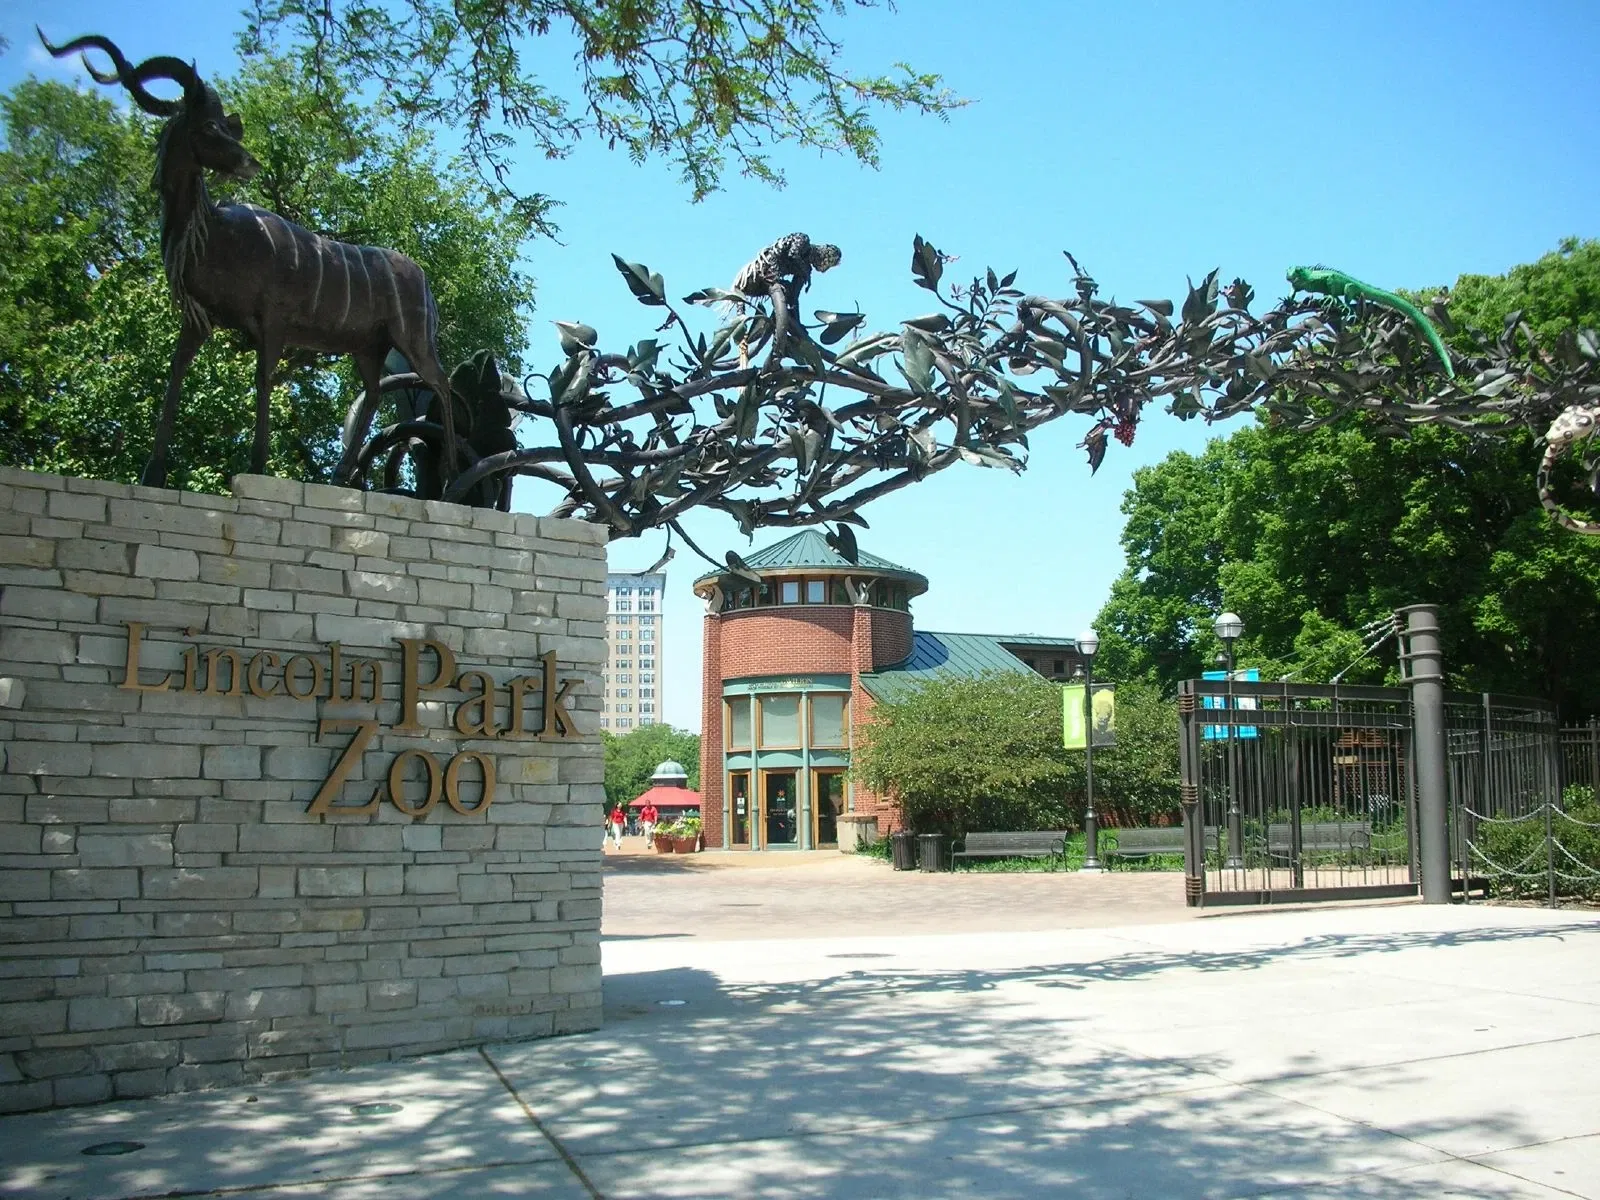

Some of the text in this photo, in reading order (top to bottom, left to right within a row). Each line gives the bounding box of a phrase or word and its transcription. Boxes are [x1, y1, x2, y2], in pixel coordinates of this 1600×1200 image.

[116, 620, 586, 742] Lincoln Park
[305, 719, 497, 817] Zoo
